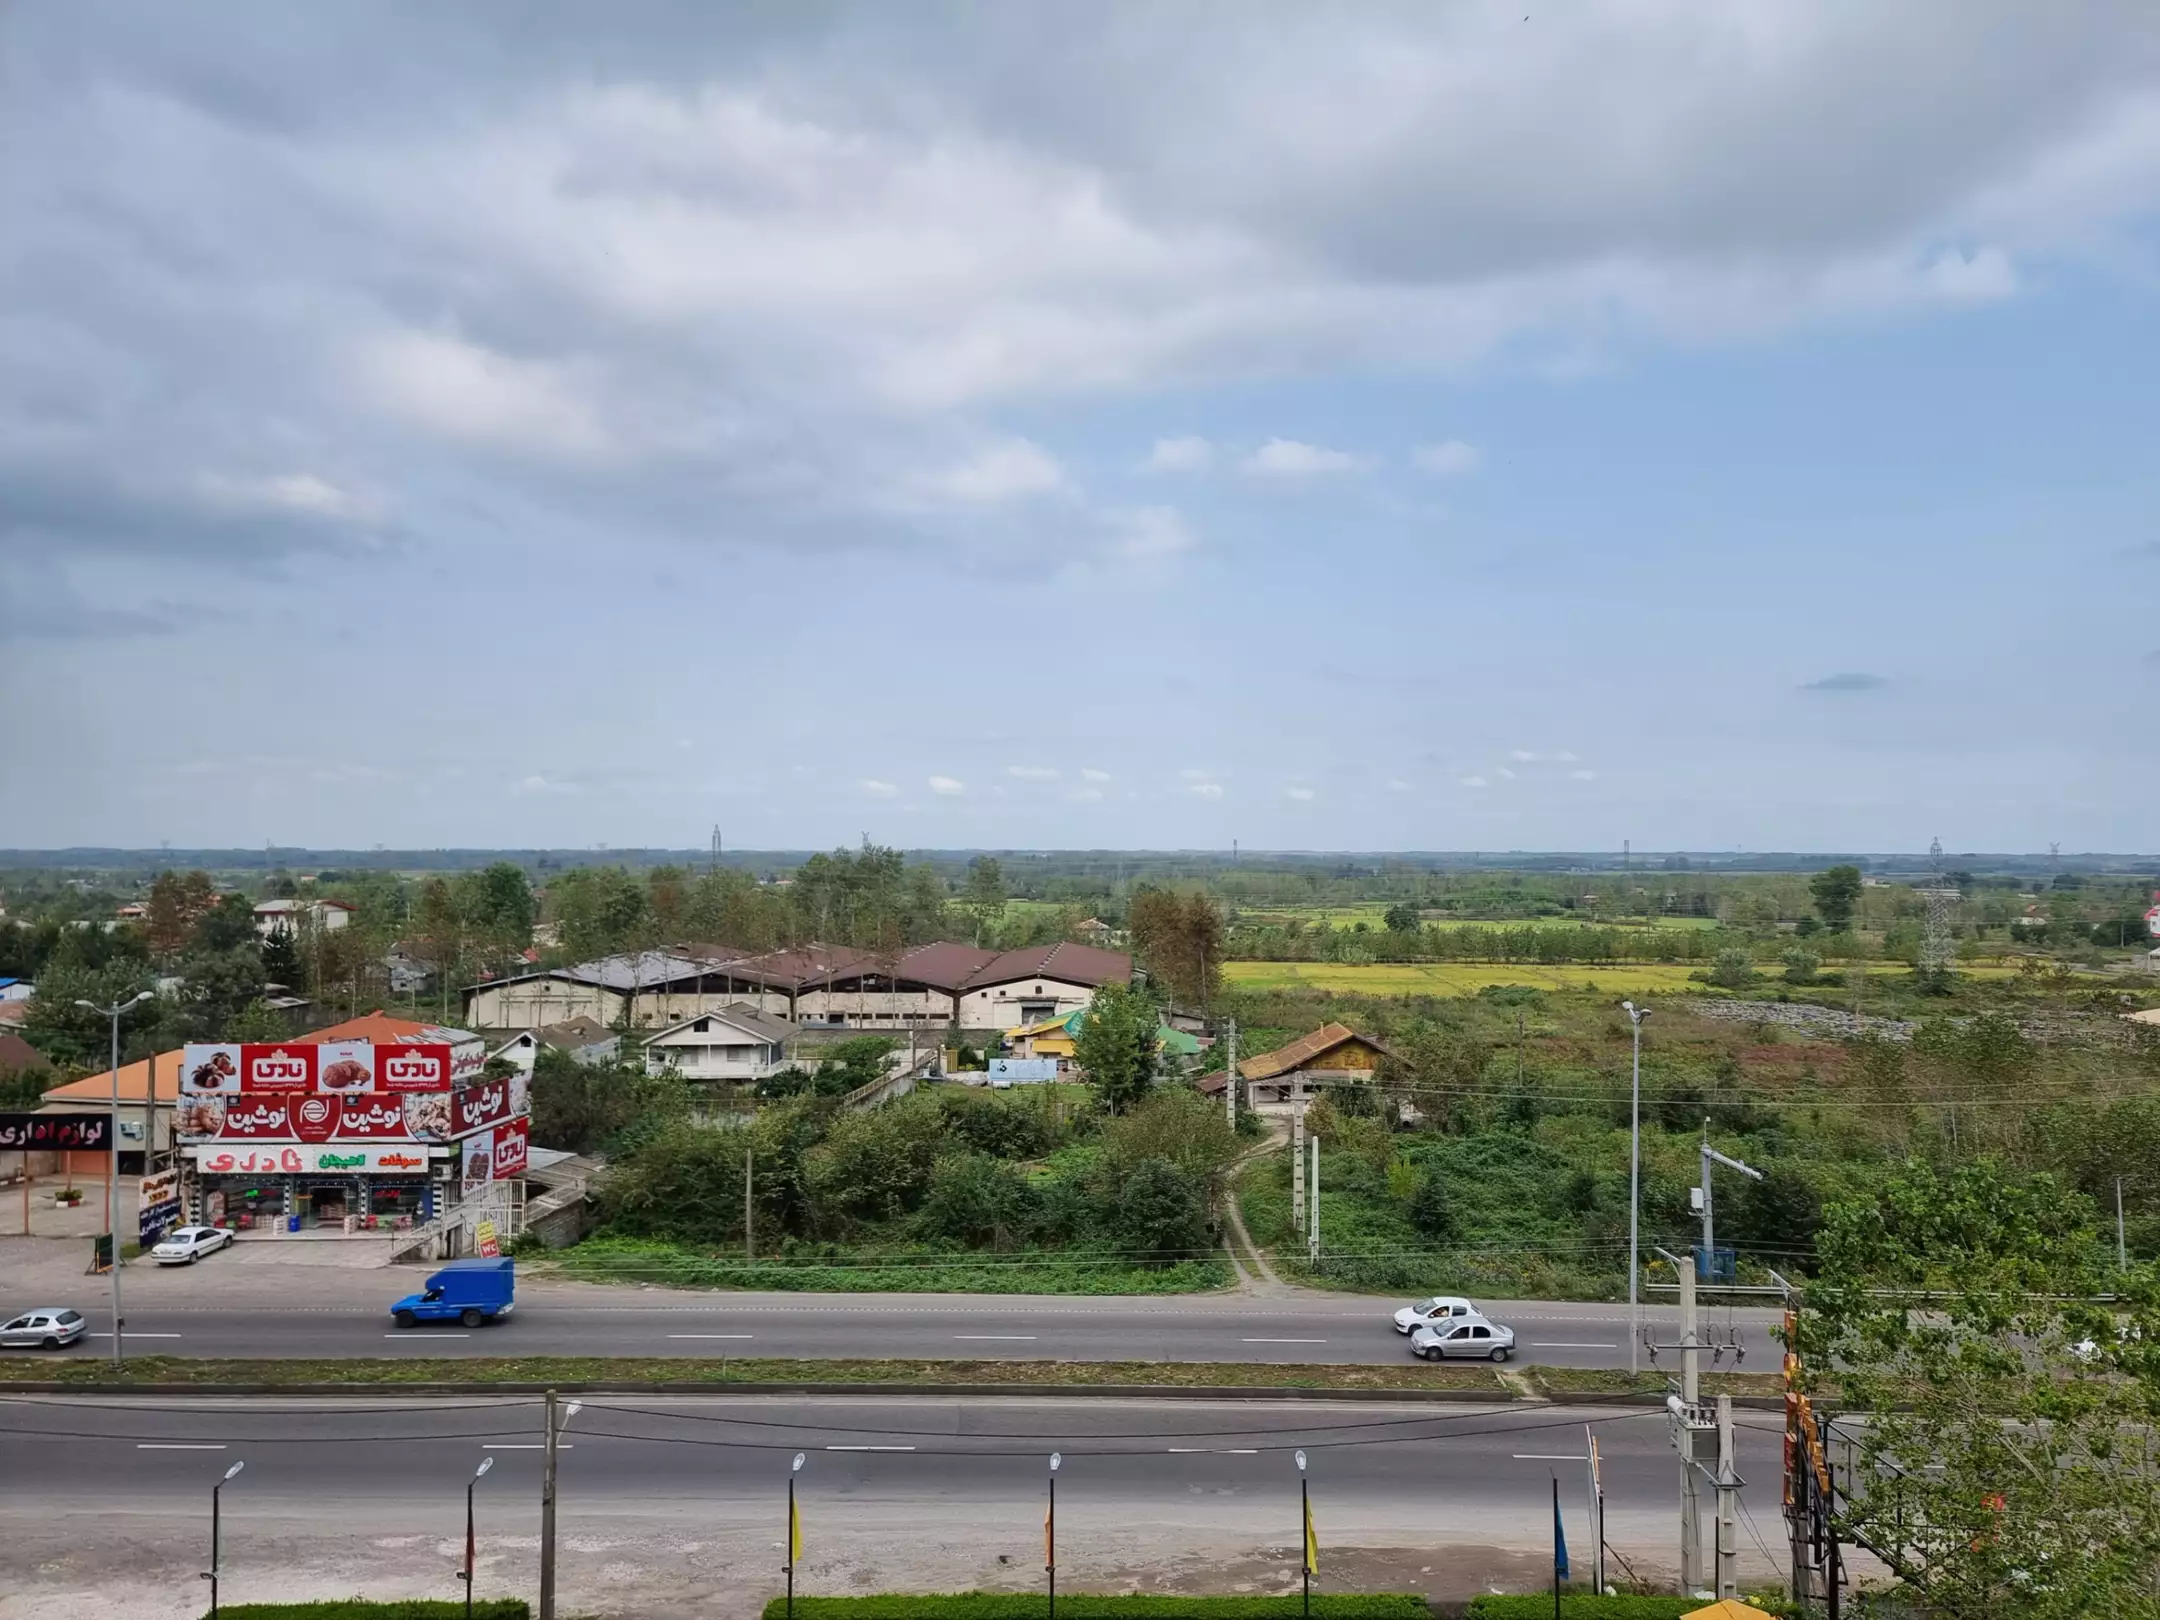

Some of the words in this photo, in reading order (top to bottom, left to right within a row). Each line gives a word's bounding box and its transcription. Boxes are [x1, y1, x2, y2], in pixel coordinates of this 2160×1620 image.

[256, 1062, 303, 1078] نادری
[390, 1062, 437, 1078] نادری
[463, 1085, 503, 1126] نوشین
[227, 1104, 286, 1134] نوشین
[342, 1103, 401, 1133] نوشین
[57, 1120, 104, 1146] لوازم
[204, 1147, 304, 1172] نادری
[318, 1153, 366, 1170] لاهیجان
[378, 1152, 423, 1170] سوغات
[482, 1243, 497, 1253] WC
